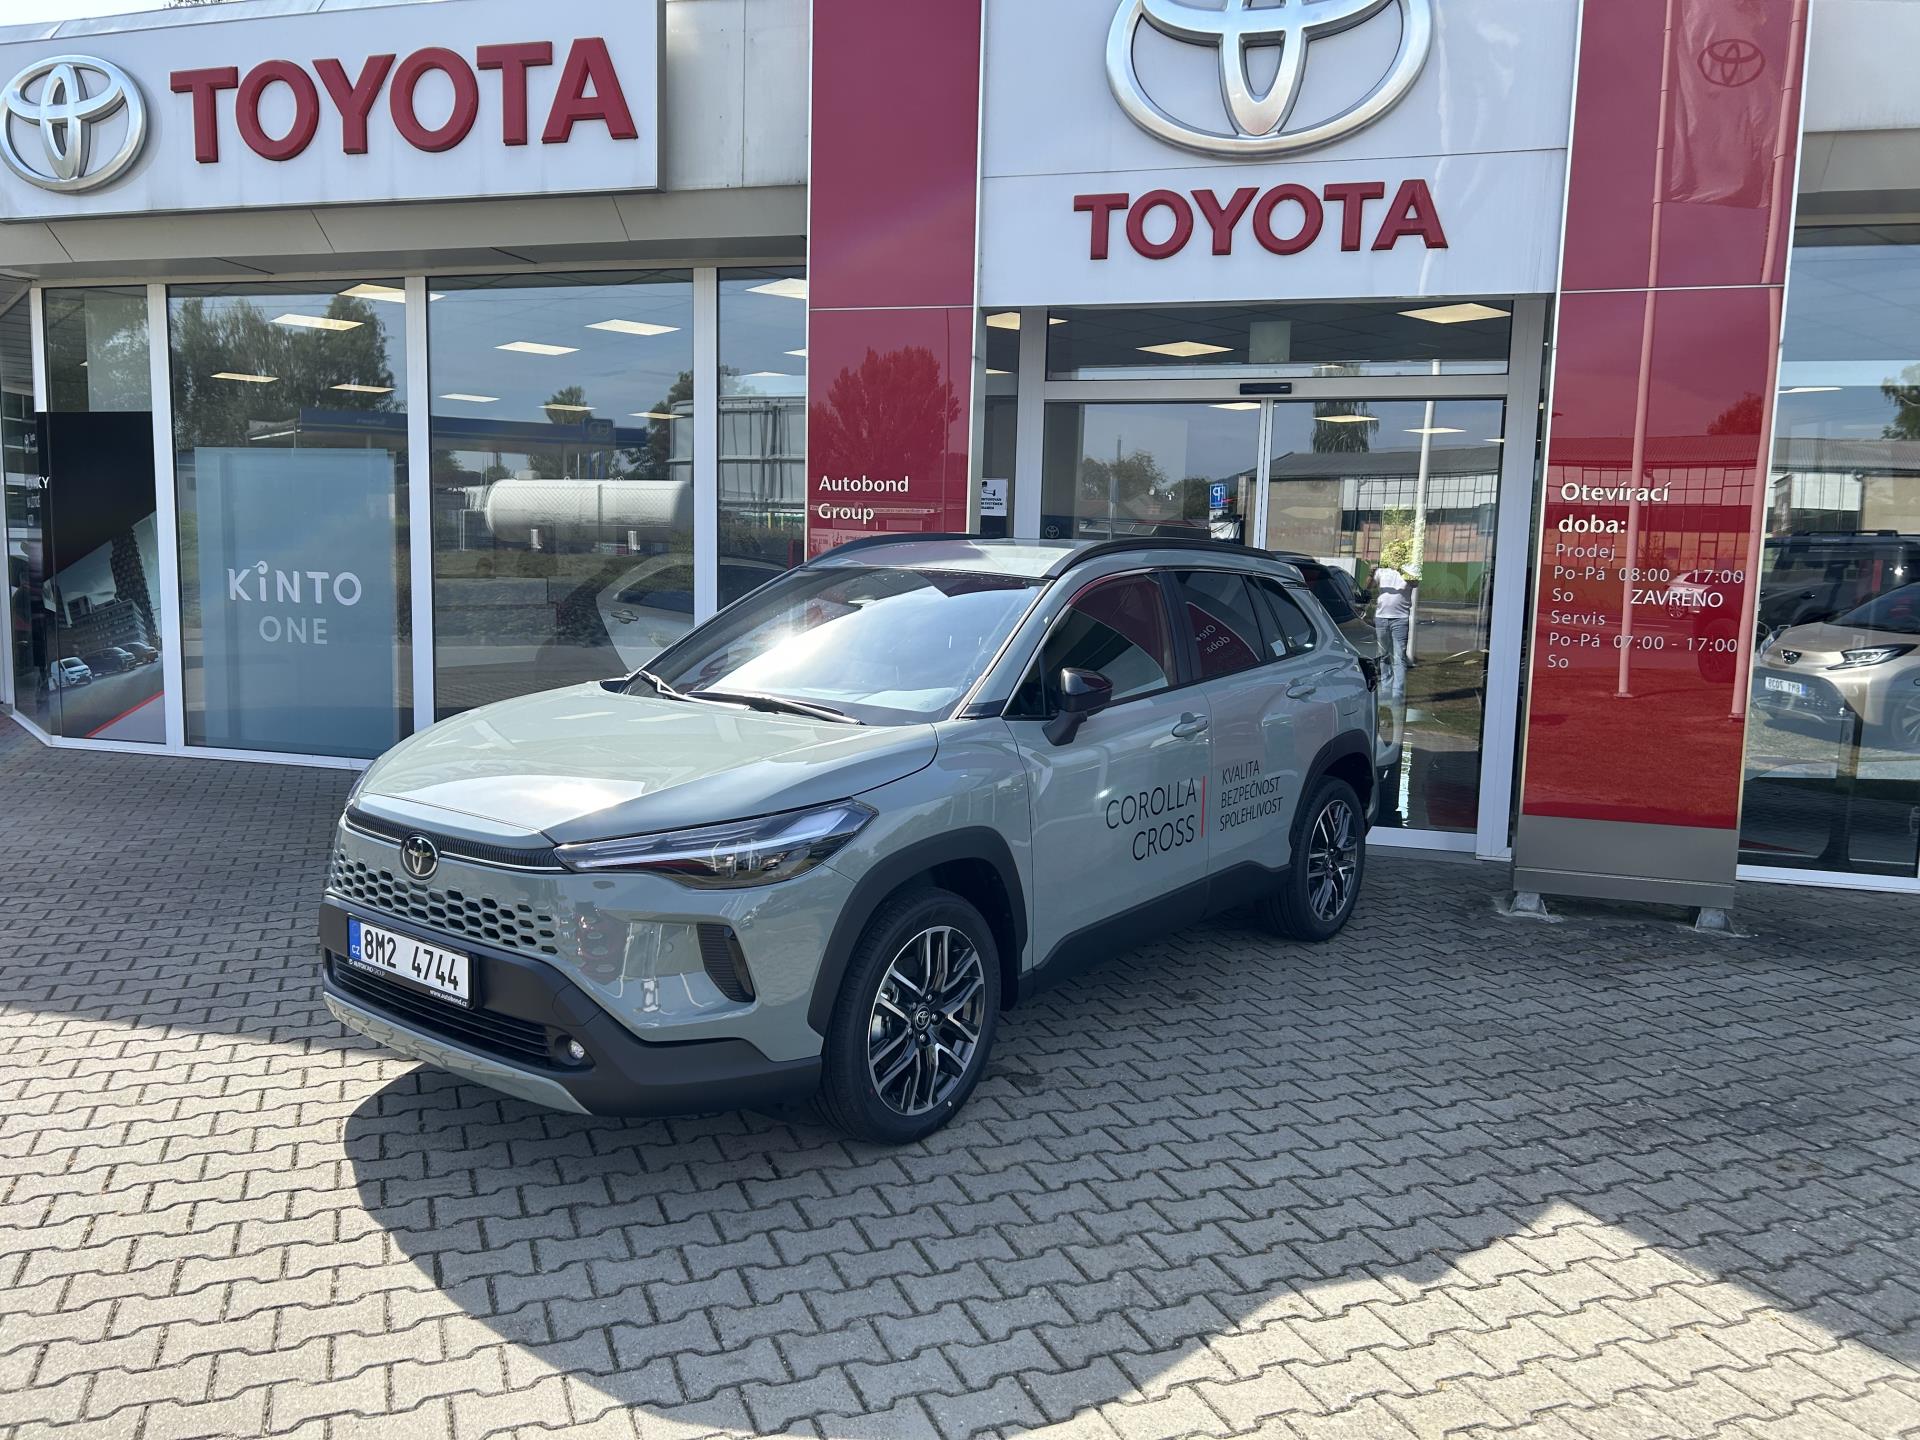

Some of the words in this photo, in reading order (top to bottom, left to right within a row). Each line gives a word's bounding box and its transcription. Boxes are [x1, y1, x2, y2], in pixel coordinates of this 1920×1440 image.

[170, 37, 639, 163] TOYOTA
[1073, 179, 1449, 260] TOYOTA
[818, 475, 909, 493] Autobond
[1560, 482, 1672, 502] Otevírací
[817, 503, 875, 525] Group
[1558, 514, 1626, 534] doba:
[1555, 543, 1616, 561] Prodej
[1553, 565, 1605, 581] Po-Pá
[1618, 567, 1670, 582] 08:00
[1692, 569, 1744, 584] 17:00
[1552, 588, 1574, 602] So
[1550, 610, 1606, 625] Servis
[258, 615, 328, 645] ONE
[1549, 632, 1601, 648] Po-Pá
[1613, 634, 1664, 650] 07:00
[1686, 637, 1738, 653] 17:00
[1547, 654, 1569, 669] So
[1222, 760, 1260, 785] KVALITA
[1221, 776, 1281, 808] BEZPEČNOST
[1106, 777, 1197, 829] COROLLA
[1219, 796, 1284, 832] SPOLEHLIVOST
[1132, 814, 1196, 861] CROSS
[351, 944, 360, 955] CZ
[364, 929, 397, 969] 8M2
[411, 946, 459, 991] 4744
